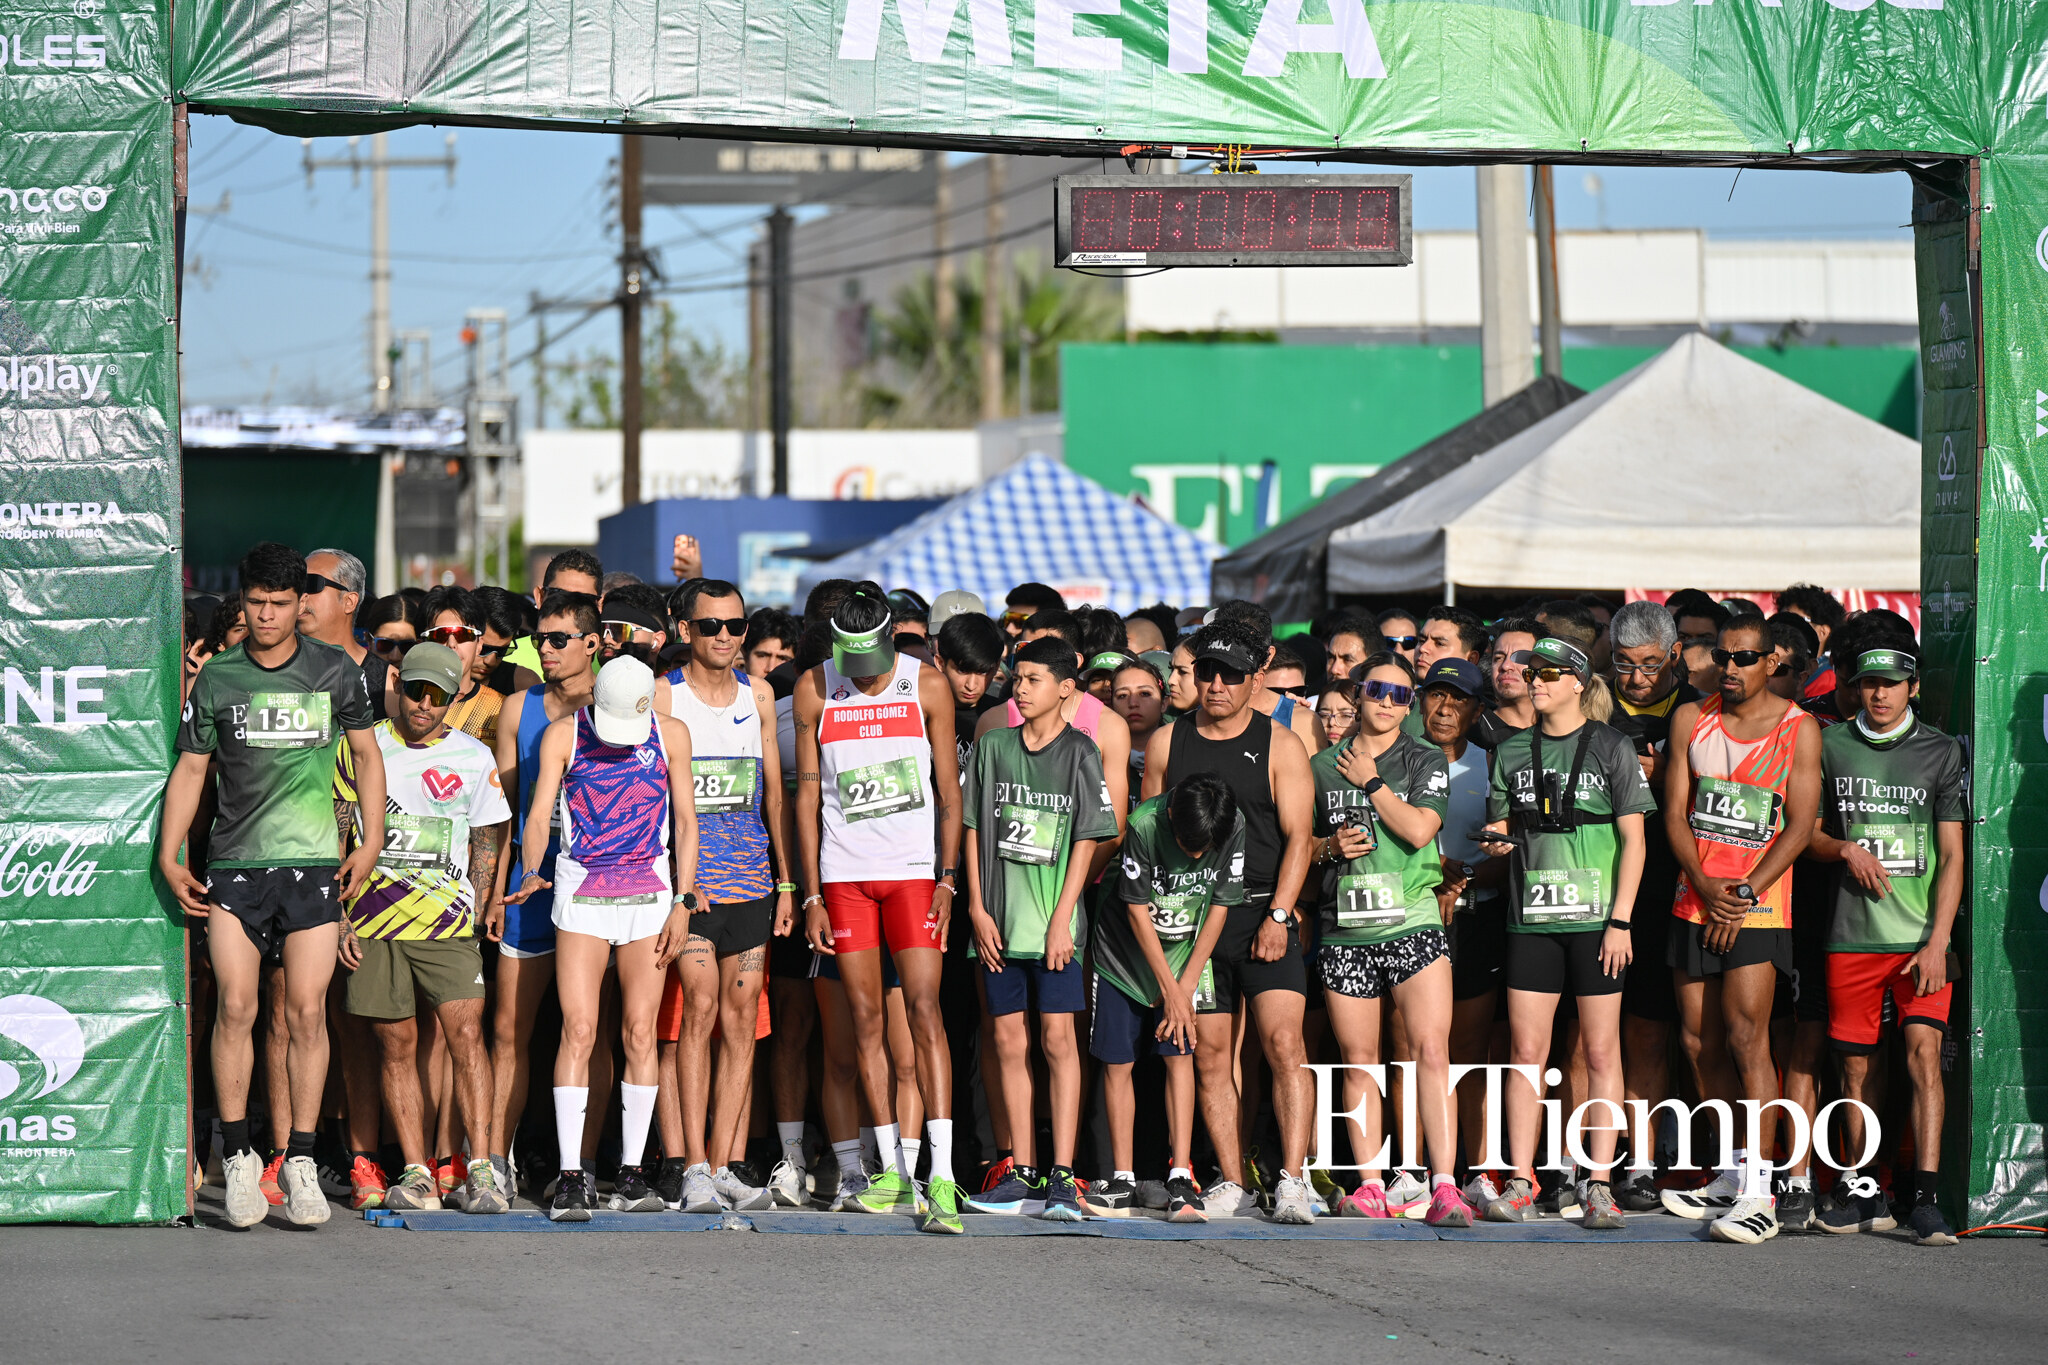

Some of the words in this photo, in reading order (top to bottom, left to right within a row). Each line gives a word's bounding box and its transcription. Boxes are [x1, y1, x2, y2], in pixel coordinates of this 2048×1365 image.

[54, 222, 80, 233] Bien
[1930, 340, 1966, 363] GLAMPING
[4, 665, 107, 726] NE
[258, 708, 309, 731] 150
[321, 703, 329, 740] MEDALLA
[833, 707, 874, 723] RODOLFO
[876, 704, 908, 721] GÓMEZ
[859, 724, 883, 738] CLUB
[693, 774, 737, 797] 287
[746, 771, 754, 805] MEDALLA
[848, 775, 899, 806] 225
[908, 767, 922, 802] MEDALLA
[994, 782, 1010, 802] El
[1012, 783, 1072, 812] Tiempo
[1835, 776, 1853, 797] El
[1856, 777, 1927, 805] Tiempo
[1326, 790, 1344, 809] El
[1705, 792, 1747, 820] 146
[1838, 800, 1855, 812] de
[1859, 801, 1909, 815] todos
[1758, 800, 1769, 834] MEDALLA
[386, 828, 422, 851] 27
[1006, 820, 1037, 846] 22
[1053, 827, 1063, 861] MEDALLA
[440, 829, 450, 864] MEDALLA
[1856, 838, 1906, 860] 314
[1347, 887, 1394, 910] 118
[1530, 883, 1580, 906] 218
[1147, 901, 1190, 927] 236
